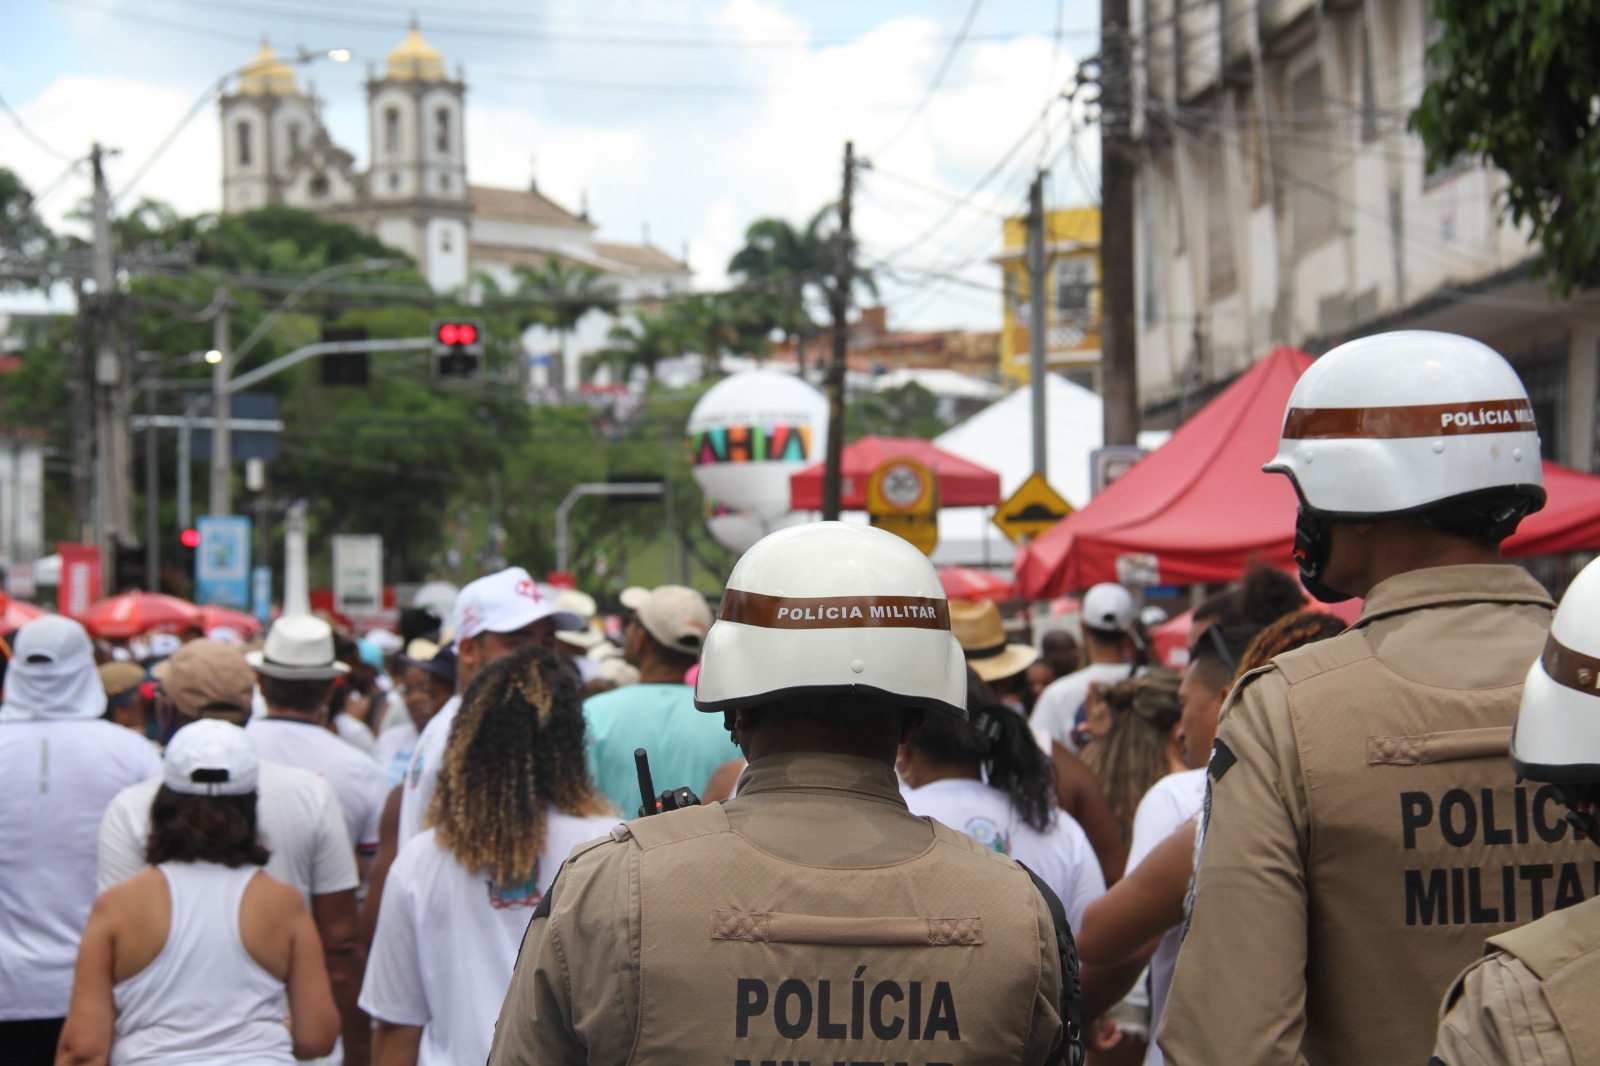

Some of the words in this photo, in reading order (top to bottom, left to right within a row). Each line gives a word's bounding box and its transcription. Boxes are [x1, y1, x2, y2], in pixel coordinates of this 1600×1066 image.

[1440, 408, 1513, 427] POLÍCIA
[776, 604, 863, 620] POLÍCIA
[869, 605, 937, 619] MILITAR
[1400, 776, 1588, 849] POLÍC
[1404, 861, 1600, 926] MILITA
[735, 965, 961, 1041] POLÍCIA
